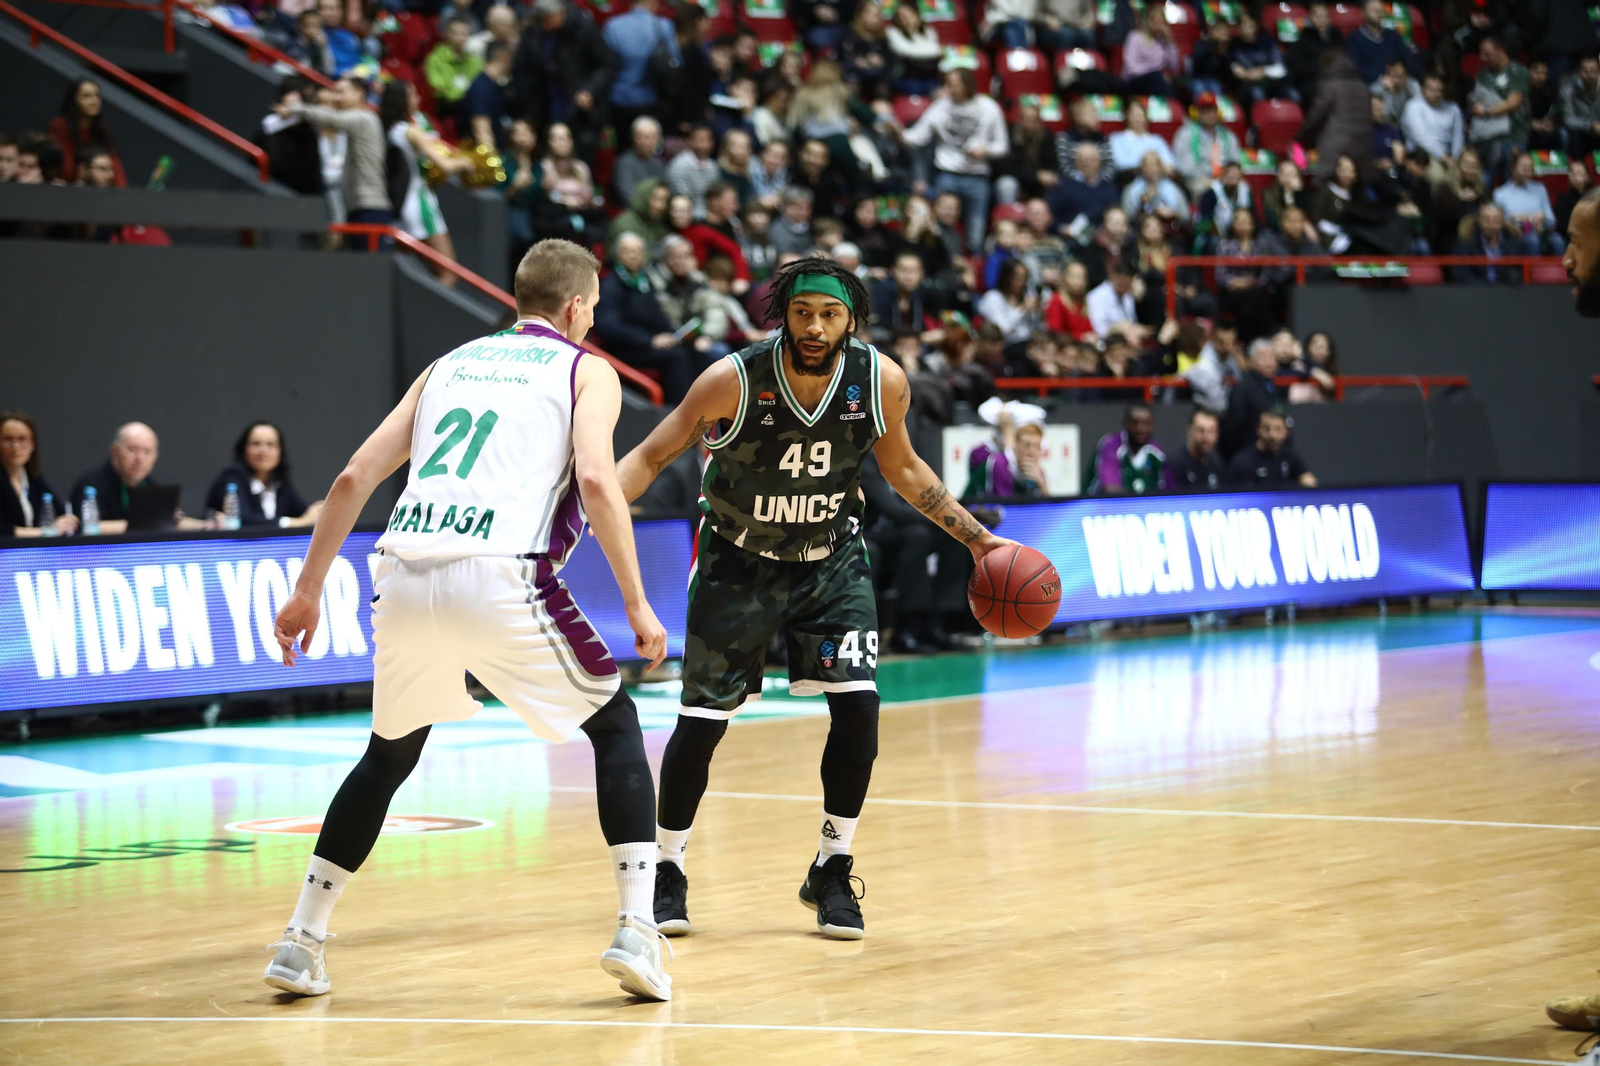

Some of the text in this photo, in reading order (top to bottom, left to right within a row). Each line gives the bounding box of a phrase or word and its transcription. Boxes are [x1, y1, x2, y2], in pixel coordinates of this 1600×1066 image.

[449, 342, 559, 365] WACZYŃSKI
[418, 407, 499, 480] 21
[778, 440, 832, 478] 49
[388, 502, 494, 540] MALAGA
[753, 492, 846, 523] UNICS
[1081, 503, 1380, 598] WIDEN YOUR WORLD
[14, 563, 215, 680] WIDEN
[838, 631, 878, 669] 49
